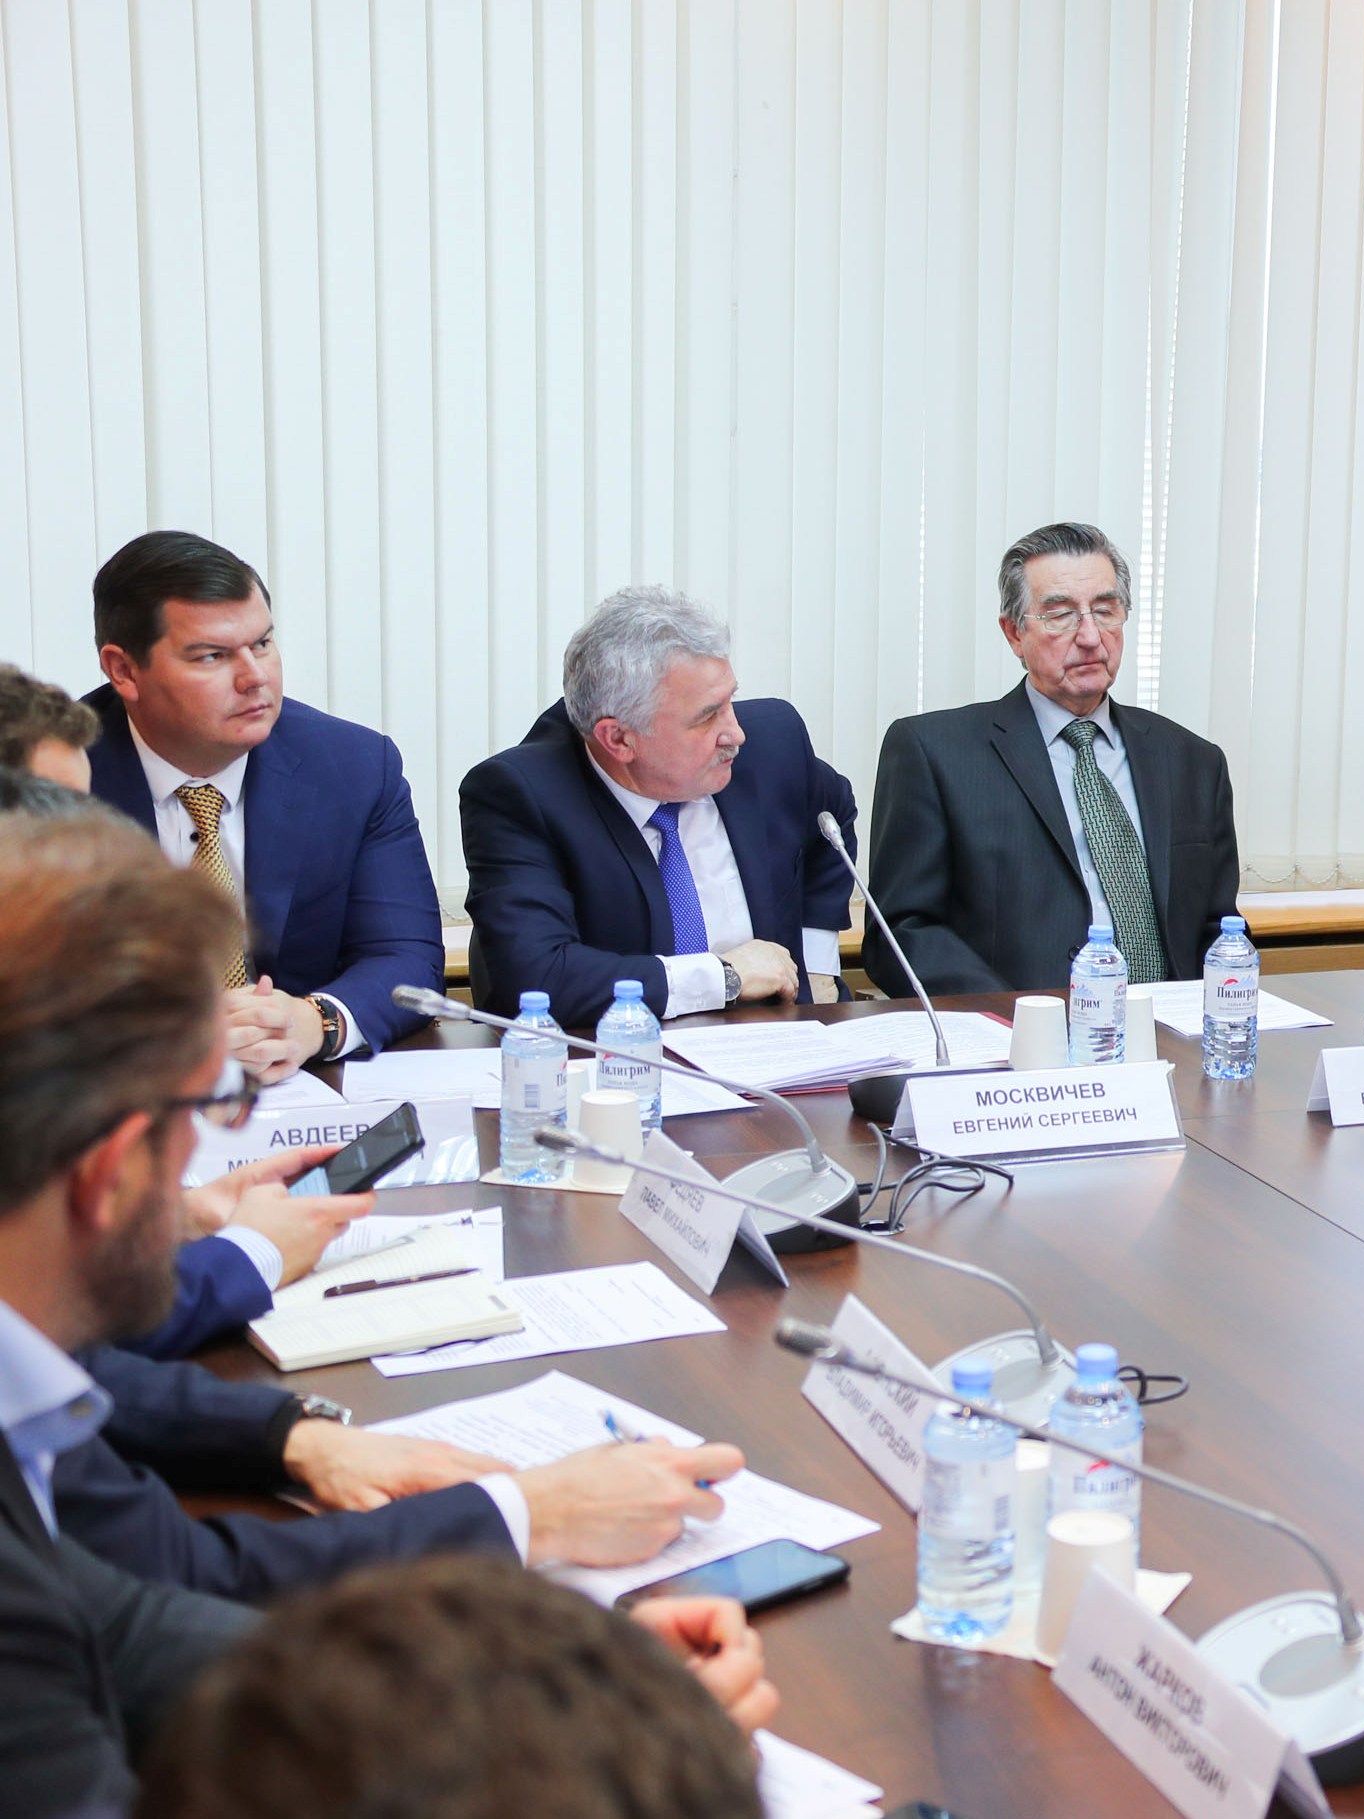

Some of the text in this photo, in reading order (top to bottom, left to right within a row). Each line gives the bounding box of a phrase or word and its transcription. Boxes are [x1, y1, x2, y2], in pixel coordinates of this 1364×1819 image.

[975, 1082, 1106, 1107] МОСКВИЧЕВ
[953, 1107, 1138, 1135] ЕВГЕНИЙ СЕРГЕЕВИЧ
